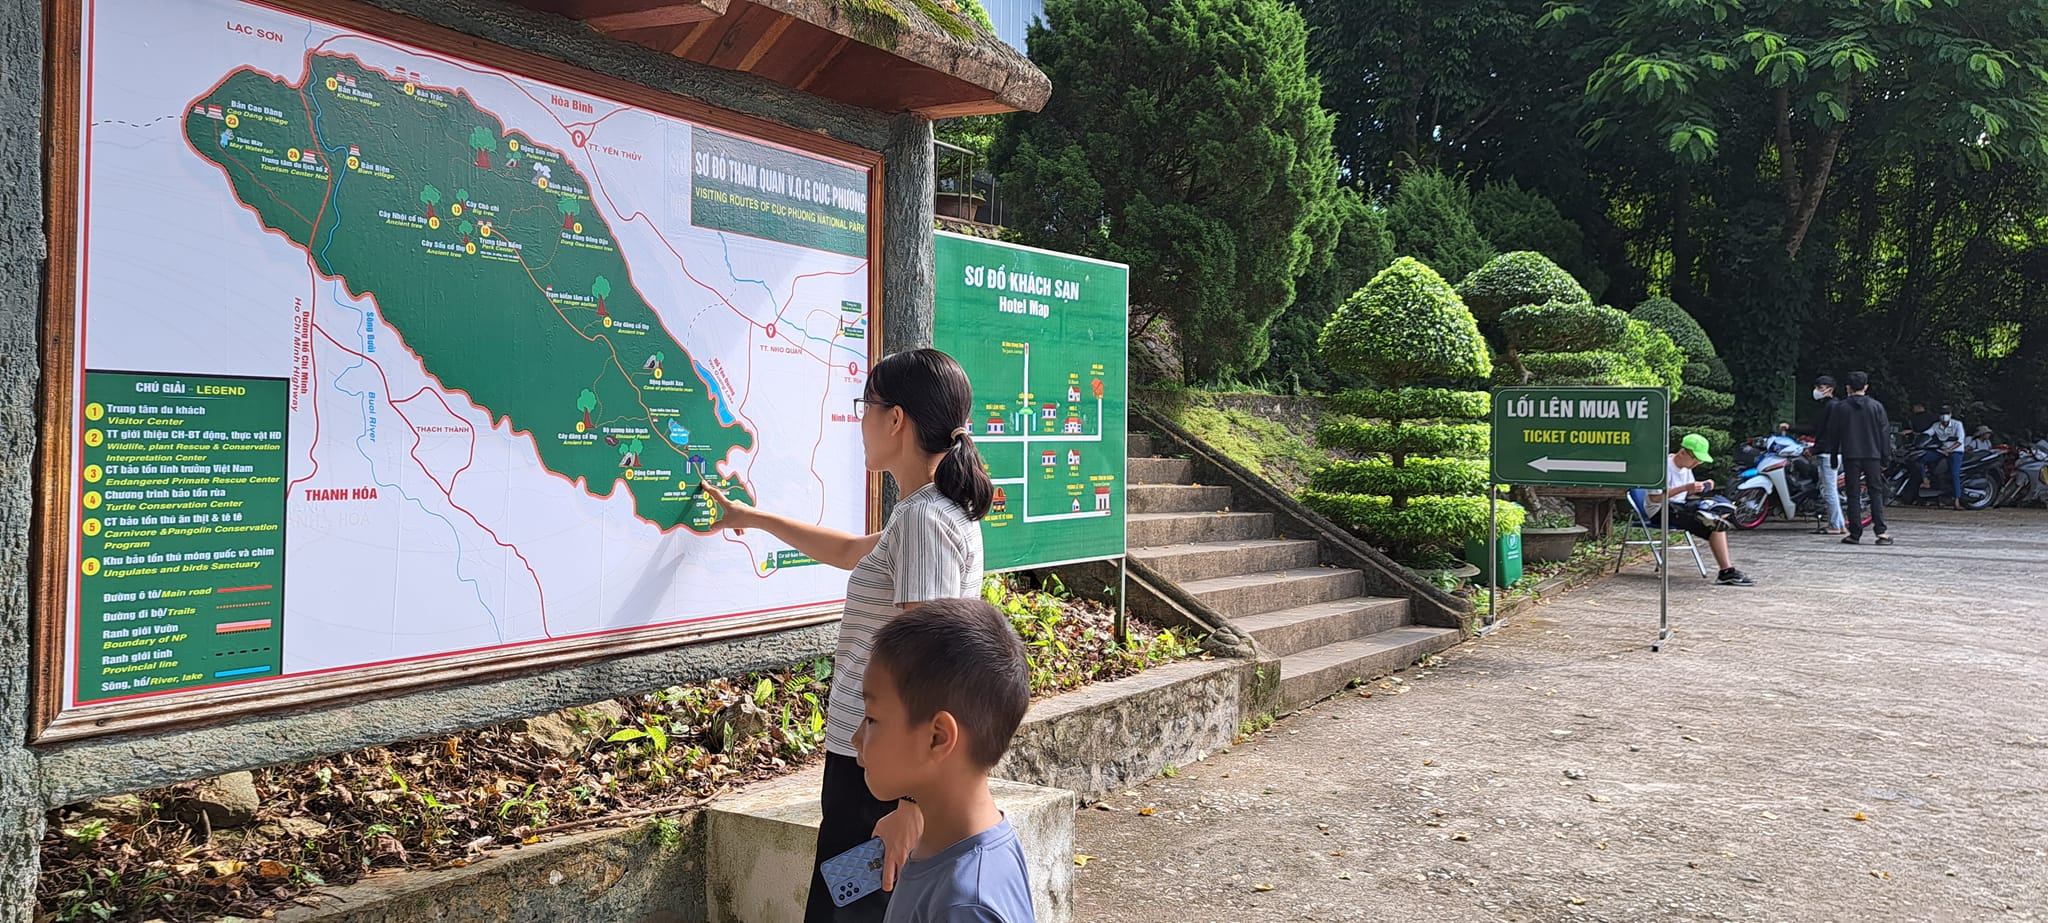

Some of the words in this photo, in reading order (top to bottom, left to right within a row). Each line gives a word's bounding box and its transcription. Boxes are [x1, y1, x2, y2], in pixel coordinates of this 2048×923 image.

[256, 28, 283, 43] SƠN
[248, 103, 262, 113] Cao
[360, 98, 381, 107] village
[265, 116, 288, 125] village
[261, 164, 289, 174] Tourism
[291, 168, 313, 177] Center
[696, 151, 710, 177] SƠ
[729, 161, 757, 188] THAM
[759, 167, 785, 195] QUAN
[788, 175, 811, 201] V.Q.G
[813, 179, 831, 206] CÚC
[833, 185, 866, 213] PHƯƠNG
[696, 187, 727, 203] VISITING
[729, 193, 759, 211] ROUTES
[760, 201, 770, 211] OF
[772, 204, 786, 216] CUC
[787, 207, 816, 222] PHUONG
[817, 213, 847, 230] NATIONAL
[849, 221, 865, 233] PARK
[965, 265, 984, 287] SƠ
[987, 264, 1006, 290] ĐỒ
[1010, 272, 1051, 296] KHÁCH
[1055, 279, 1079, 303] SẠN
[999, 296, 1026, 314] Hotel
[1029, 300, 1049, 319] Map
[366, 311, 375, 333] Sông
[293, 337, 301, 363] Minh
[785, 347, 802, 355] QUAN
[136, 381, 159, 392] CHÚ
[162, 381, 185, 393] GIẢI
[196, 385, 246, 395] LEGEND
[291, 366, 300, 412] Highway
[301, 371, 309, 394] Minh
[107, 404, 136, 414] Trung
[139, 405, 158, 414] tâm
[161, 405, 173, 414] du
[176, 406, 205, 415] khách
[1507, 394, 1534, 418] LỐI
[1540, 395, 1573, 418] LÊN
[1580, 400, 1620, 418] MUA
[1626, 397, 1649, 419] VÉ
[108, 417, 144, 425] Visitor
[147, 417, 184, 425] Center
[106, 430, 119, 438] TT
[143, 430, 169, 440] thiệu
[171, 430, 201, 439] CH-BT
[203, 431, 229, 440] động,
[231, 431, 252, 441] thực
[1523, 429, 1566, 443] TICKET
[1570, 430, 1630, 445] COUNTER
[148, 443, 174, 451] plant
[105, 465, 119, 474] CT
[121, 464, 139, 474] bảo
[160, 465, 178, 473] linh
[213, 464, 230, 474] Việt
[232, 464, 253, 472] Nam
[106, 478, 169, 486] Endangered
[172, 488, 190, 498] bảo
[305, 489, 348, 501] THANH
[352, 486, 377, 500] HÓA
[106, 503, 136, 511] Turtle
[139, 502, 207, 510] Conservation
[104, 517, 118, 526] CT
[120, 516, 139, 526] bảo
[211, 514, 219, 522] &
[104, 529, 157, 538] Carnivore
[214, 524, 277, 533] Conservation
[104, 541, 150, 550] Program
[103, 556, 123, 565] Khu
[126, 554, 145, 564] bảo
[238, 549, 250, 557] và
[251, 548, 274, 557] chim
[103, 567, 158, 578] Ungulates
[160, 565, 181, 573] and
[182, 563, 209, 572] birds
[211, 561, 261, 570] Sanctuary
[188, 587, 213, 596] road
[138, 609, 148, 618] đi
[103, 629, 129, 639] Ranh
[103, 638, 156, 649] Boundary
[171, 634, 188, 642] NP
[102, 654, 128, 665] Ranh
[102, 662, 157, 675] Provincial
[101, 681, 131, 691] Sông,
[182, 673, 203, 681] lake
